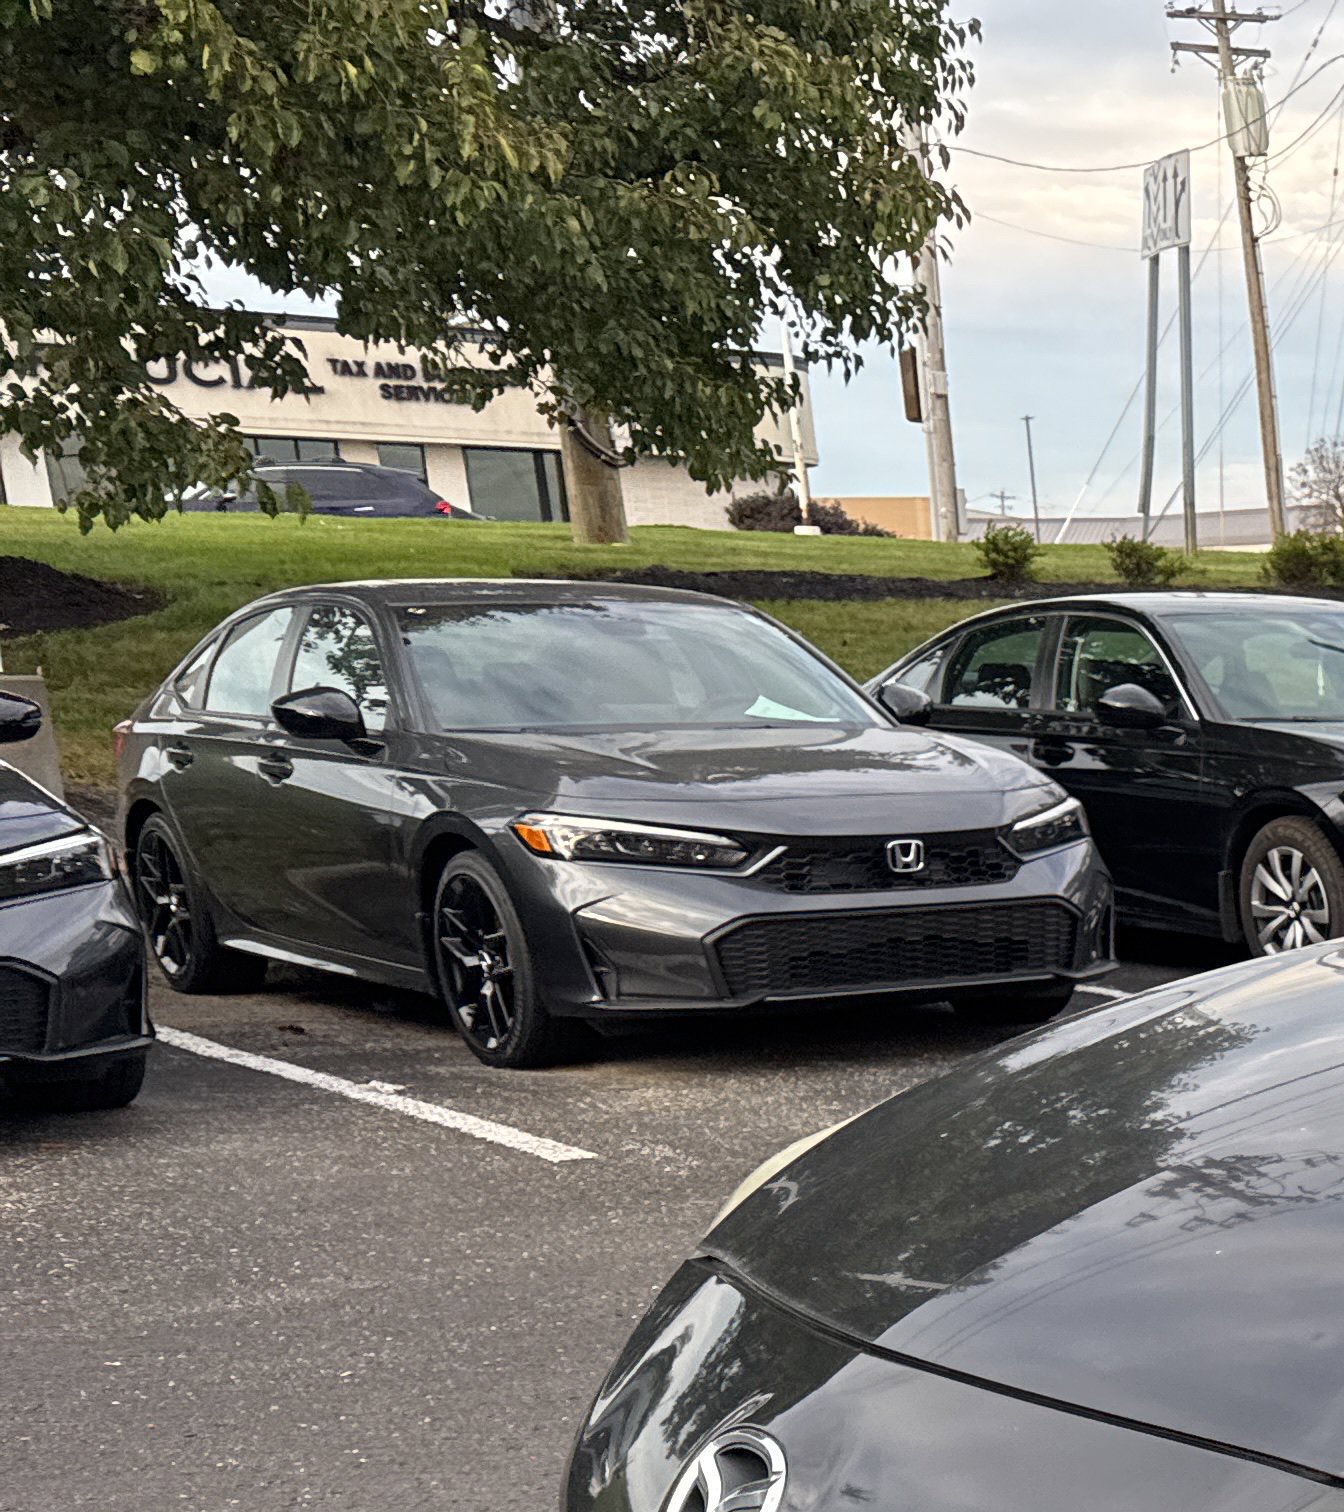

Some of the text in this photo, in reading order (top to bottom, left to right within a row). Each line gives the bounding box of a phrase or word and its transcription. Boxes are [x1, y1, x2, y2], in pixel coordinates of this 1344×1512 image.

[326, 358, 369, 377] TAX
[373, 361, 417, 381] AND
[378, 383, 463, 403] SERVIC
